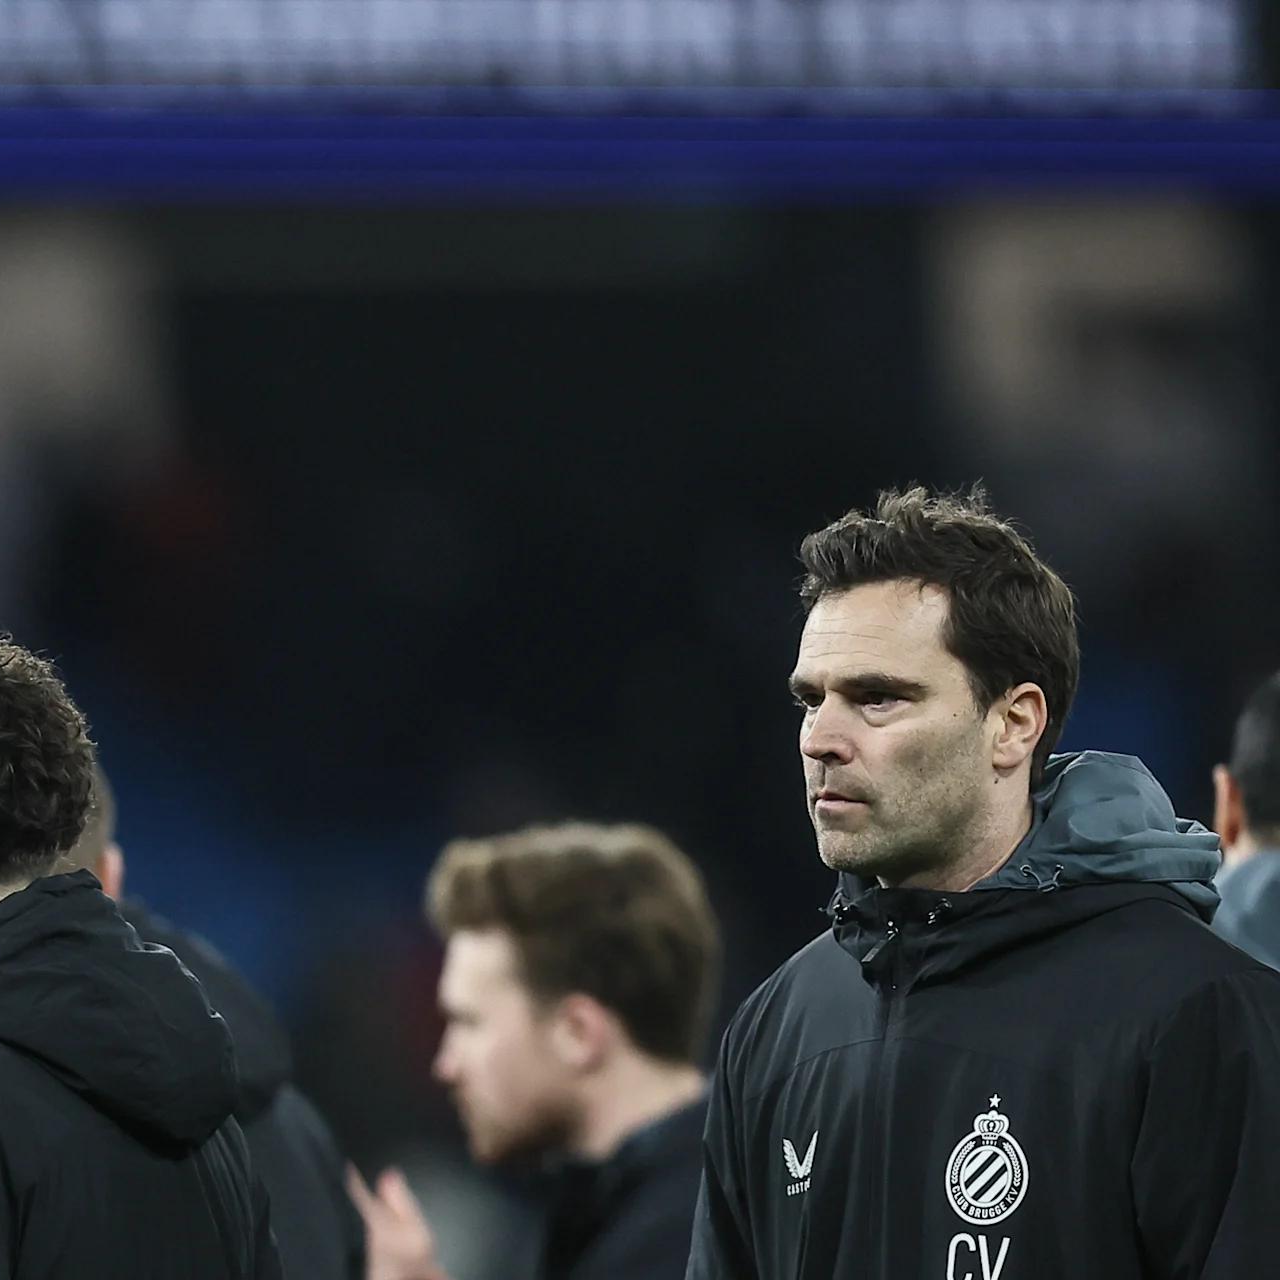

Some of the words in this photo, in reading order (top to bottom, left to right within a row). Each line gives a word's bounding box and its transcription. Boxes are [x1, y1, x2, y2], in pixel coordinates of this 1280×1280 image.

[952, 1185, 969, 1211] CLUB
[968, 1202, 1008, 1219] BRUGGE
[1005, 1187, 1019, 1204] KV
